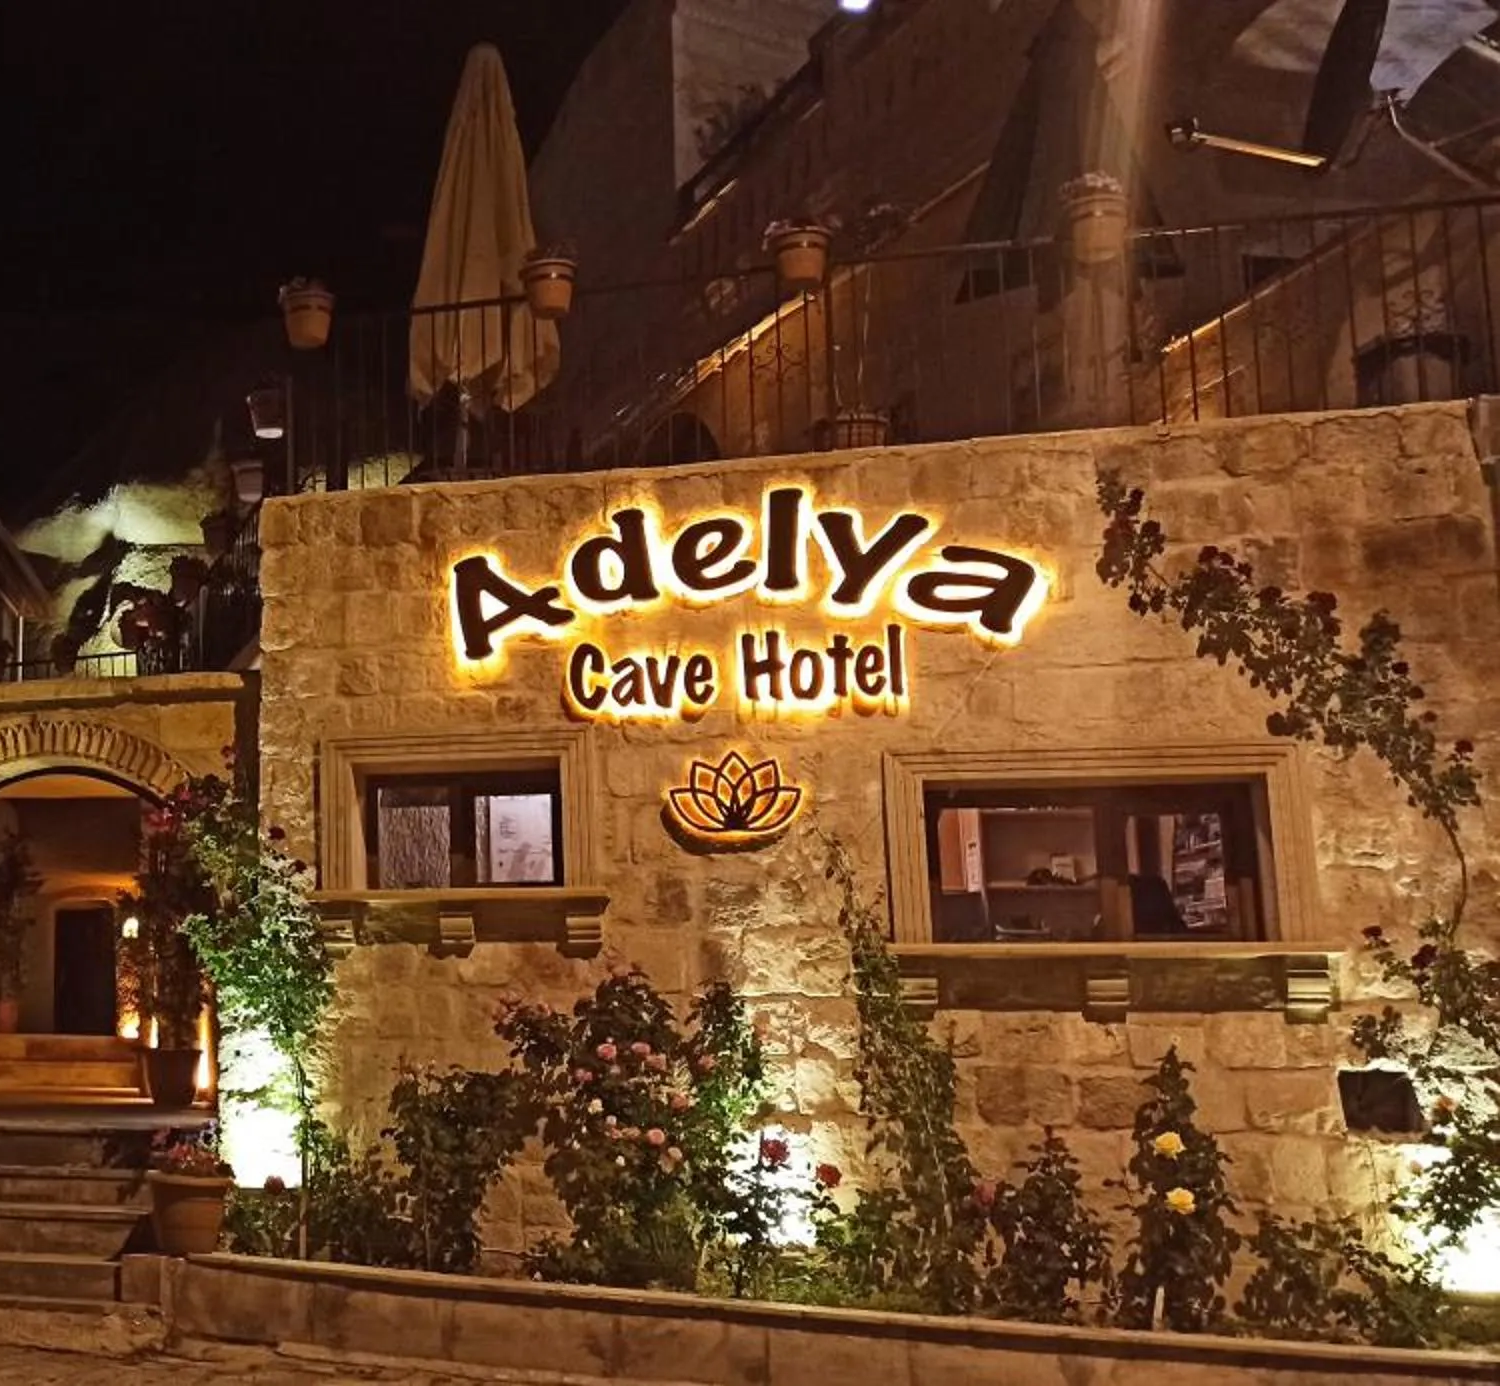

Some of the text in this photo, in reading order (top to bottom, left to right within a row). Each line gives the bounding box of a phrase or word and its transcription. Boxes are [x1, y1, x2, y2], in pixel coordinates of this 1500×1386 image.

[453, 488, 1036, 660] Adelya
[569, 624, 904, 709] Cave Hotel
